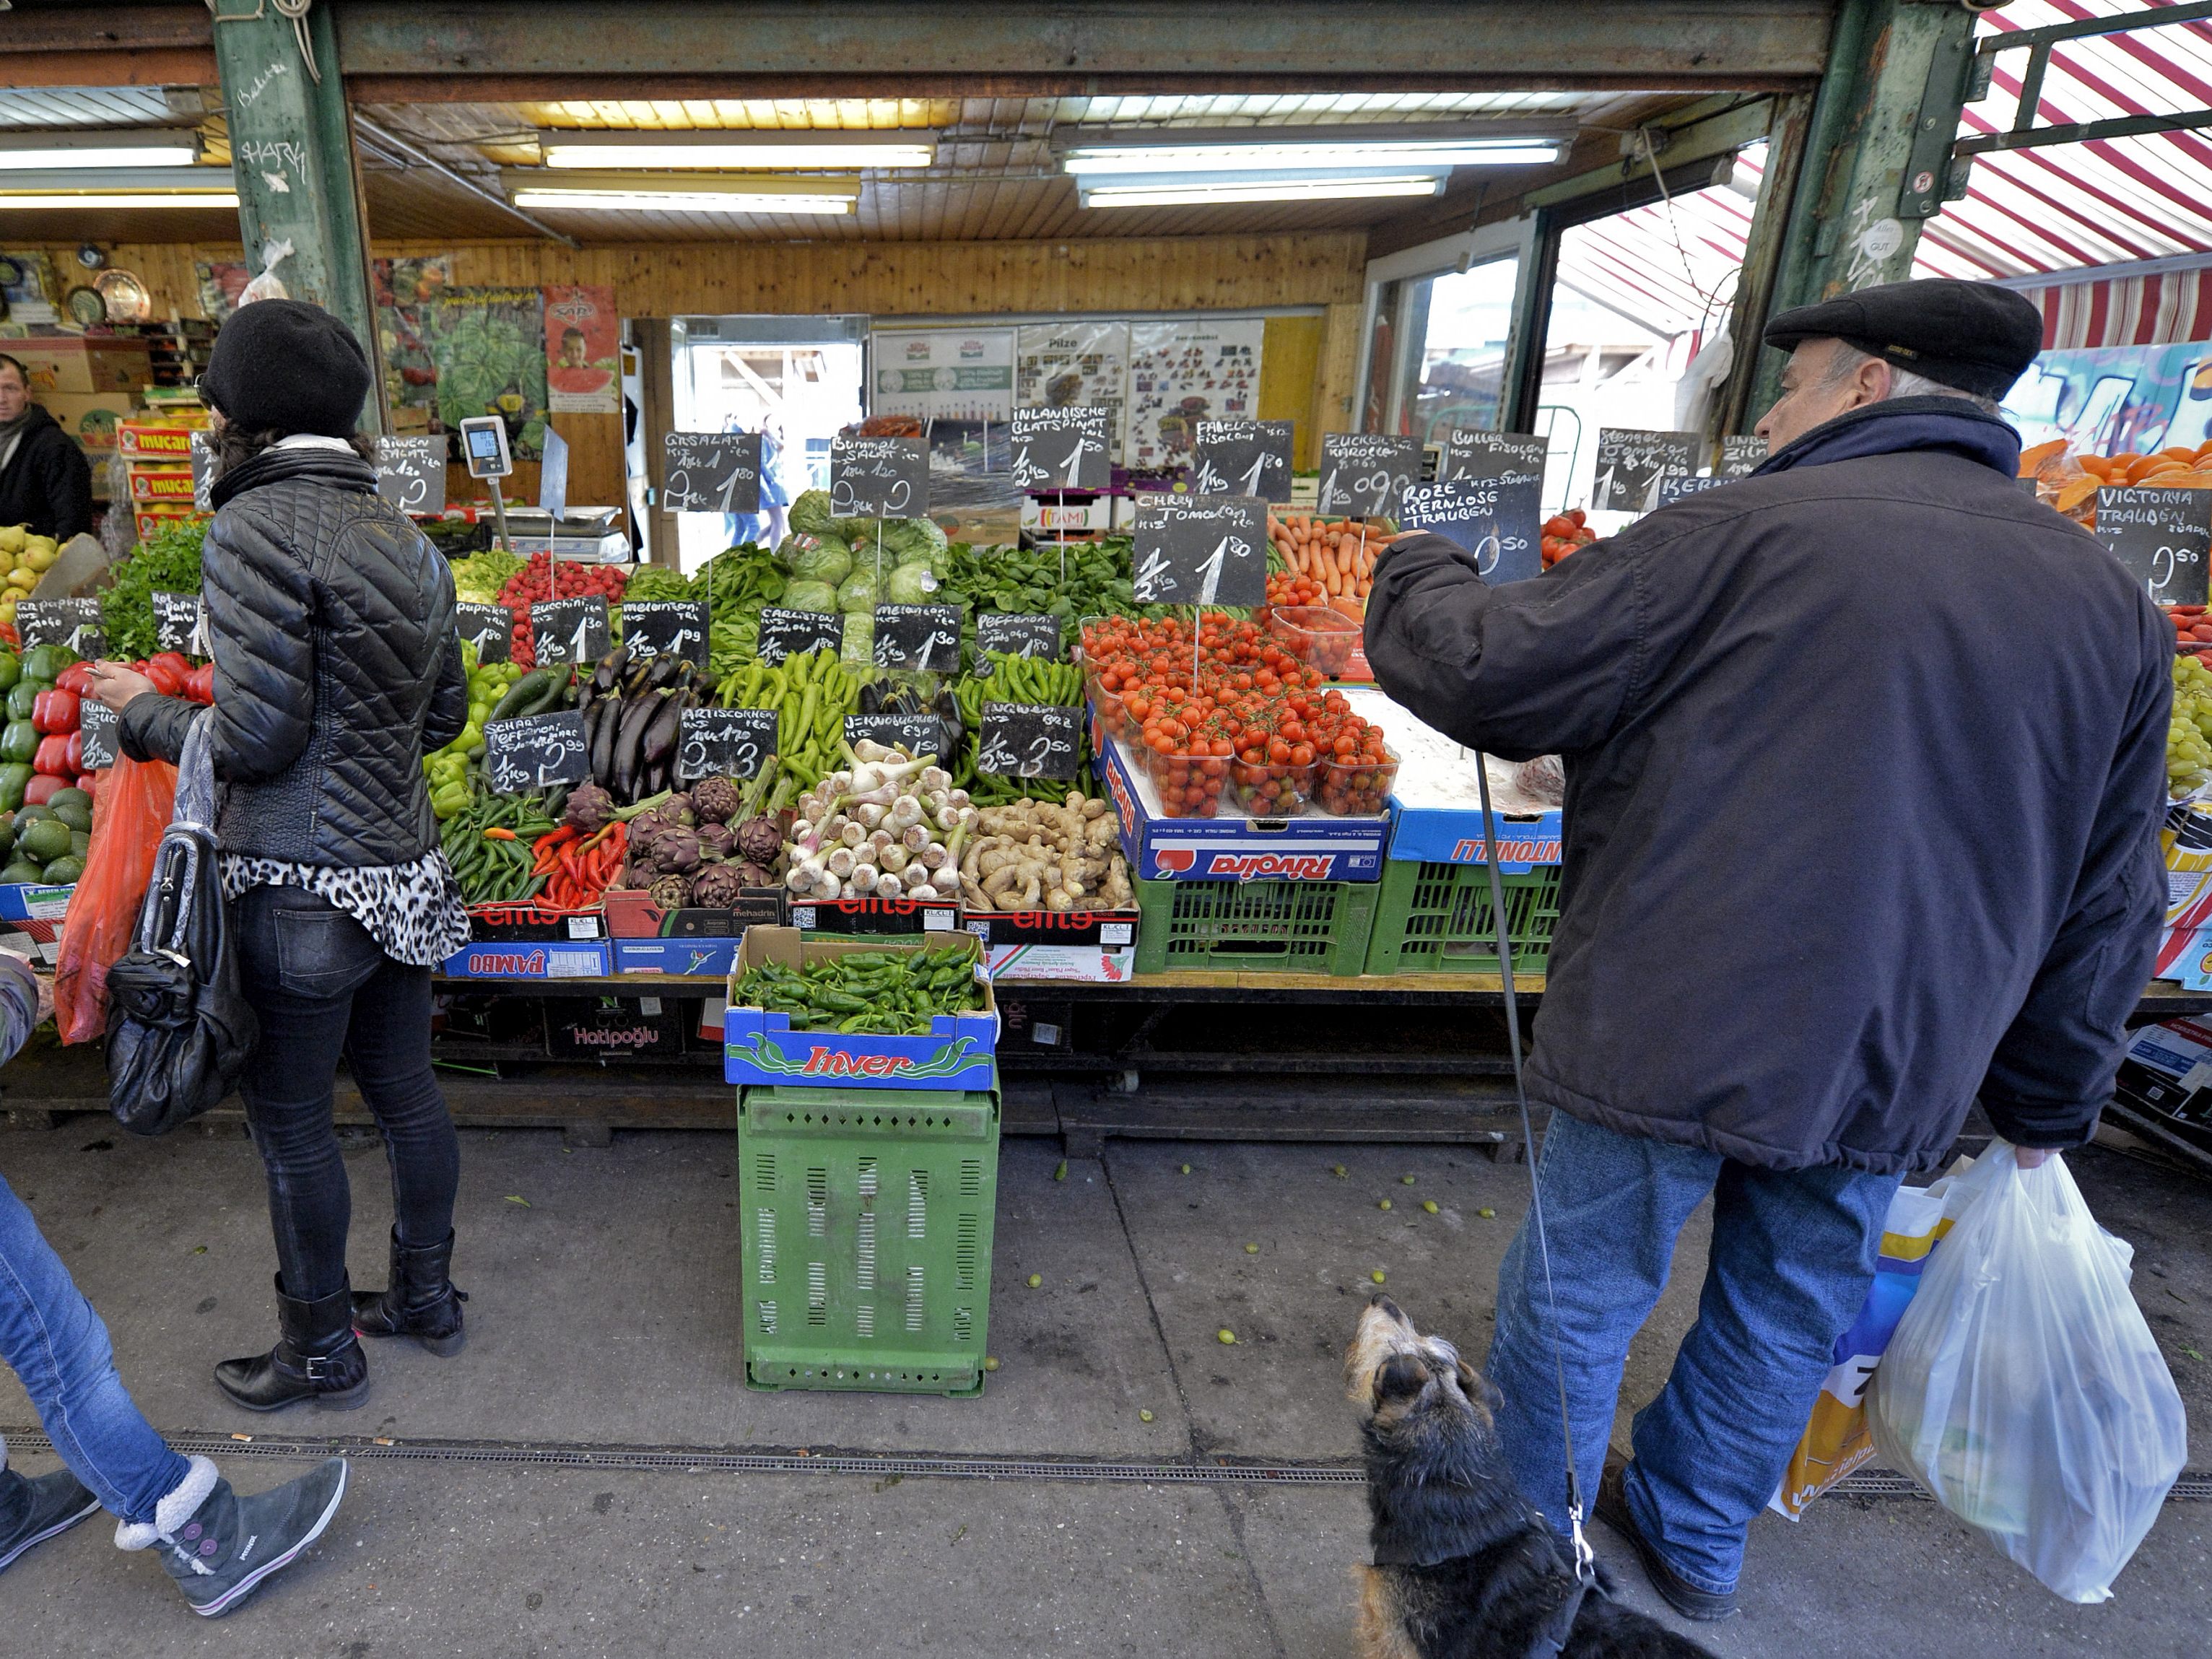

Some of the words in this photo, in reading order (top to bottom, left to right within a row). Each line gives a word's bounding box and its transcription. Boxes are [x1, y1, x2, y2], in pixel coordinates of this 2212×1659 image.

[1871, 242, 1890, 251] GUT
[1048, 339, 1078, 348] Pilze
[1405, 491, 1499, 515] KERNLOSE
[1050, 512, 1084, 524] TAMI
[1403, 507, 1493, 528] TRAUBEN
[1195, 536, 1251, 604] 180
[531, 598, 586, 614] zucchini
[471, 627, 502, 664] 180
[570, 616, 604, 663] 130
[915, 630, 956, 671] 130
[1106, 754, 1136, 838] Rivoira
[1207, 854, 1337, 880] Rivoira
[801, 1046, 916, 1076] Inver
[239, 1535, 258, 1561] MEINDL
